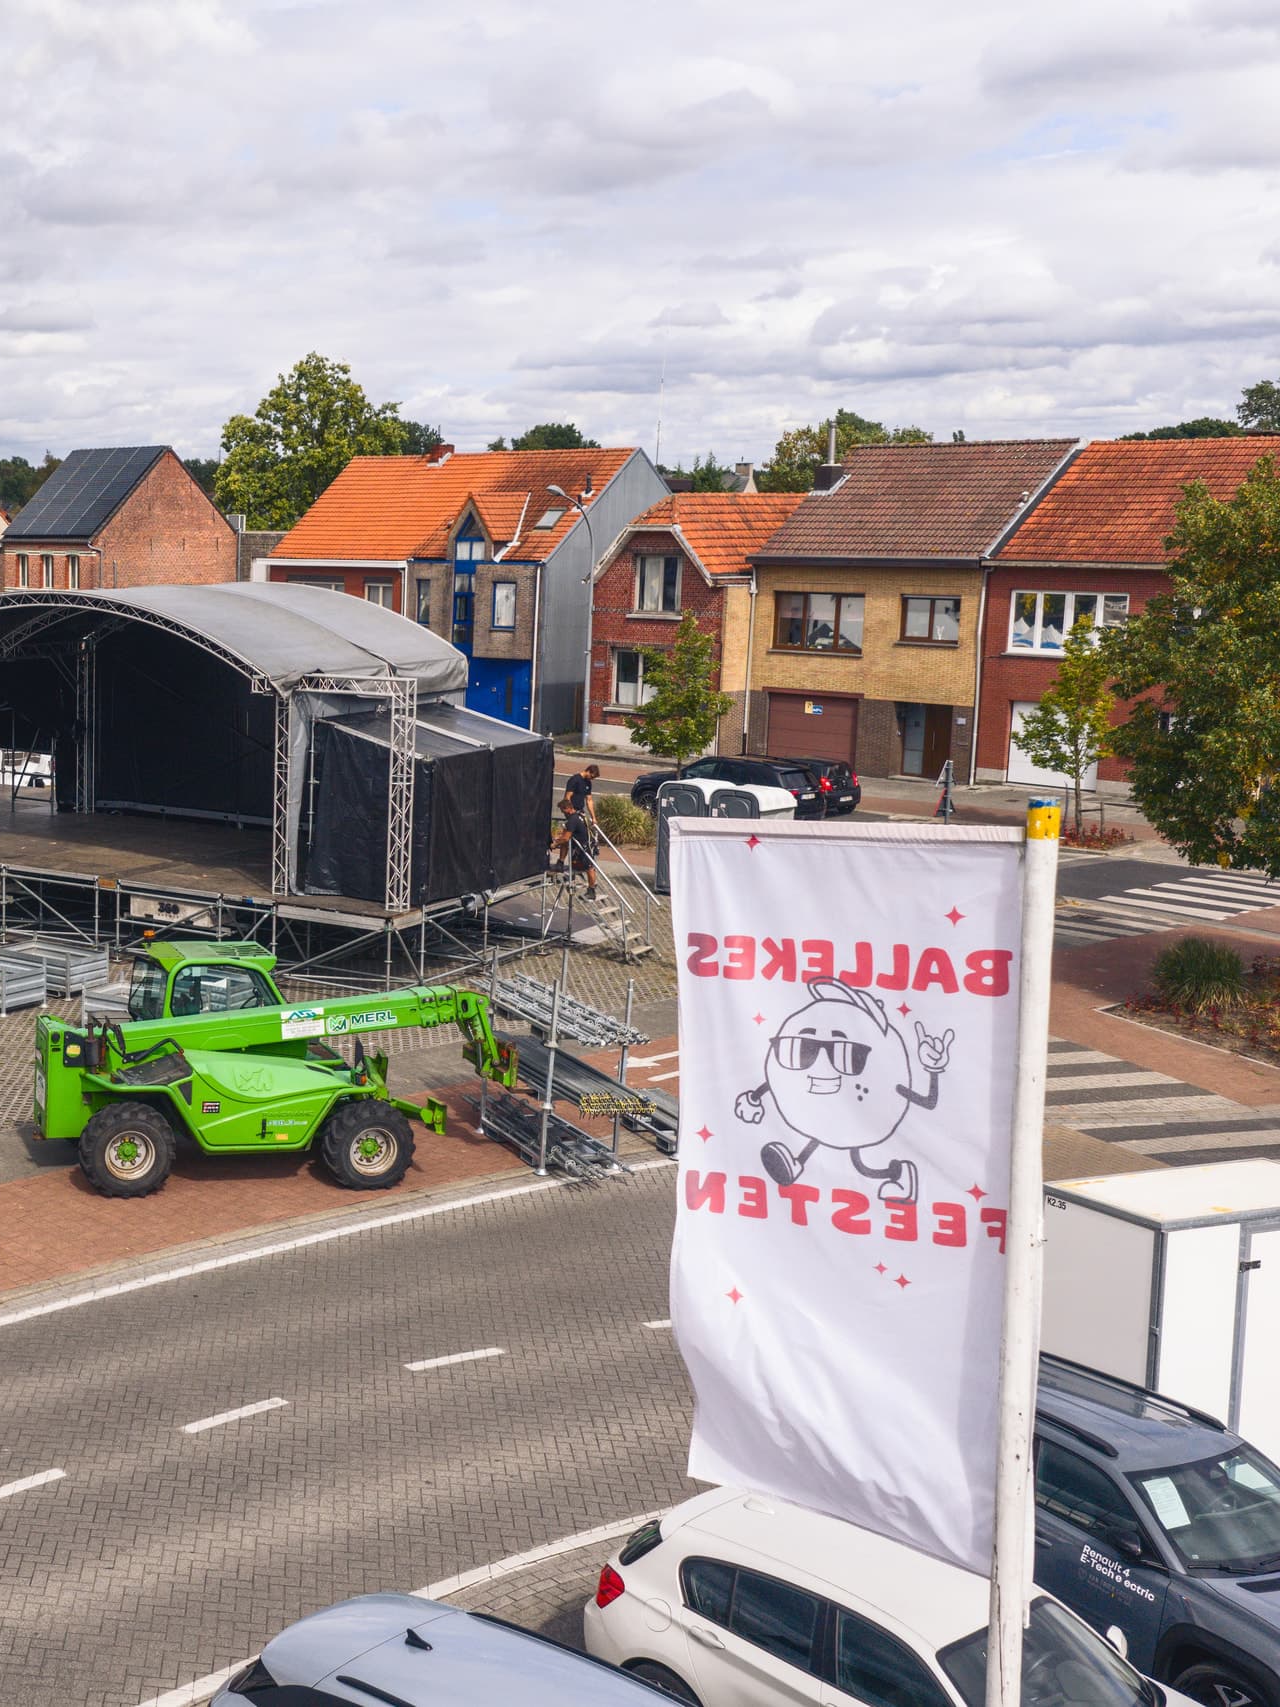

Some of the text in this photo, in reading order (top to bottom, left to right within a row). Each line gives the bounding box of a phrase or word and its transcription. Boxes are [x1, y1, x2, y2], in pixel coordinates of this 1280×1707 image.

[158, 902, 180, 914] 360
[351, 1010, 396, 1025] MERL
[1047, 1196, 1067, 1211] K2.35
[1080, 1553, 1115, 1579] E-Tech
[1082, 1544, 1130, 1577] Renault 4
